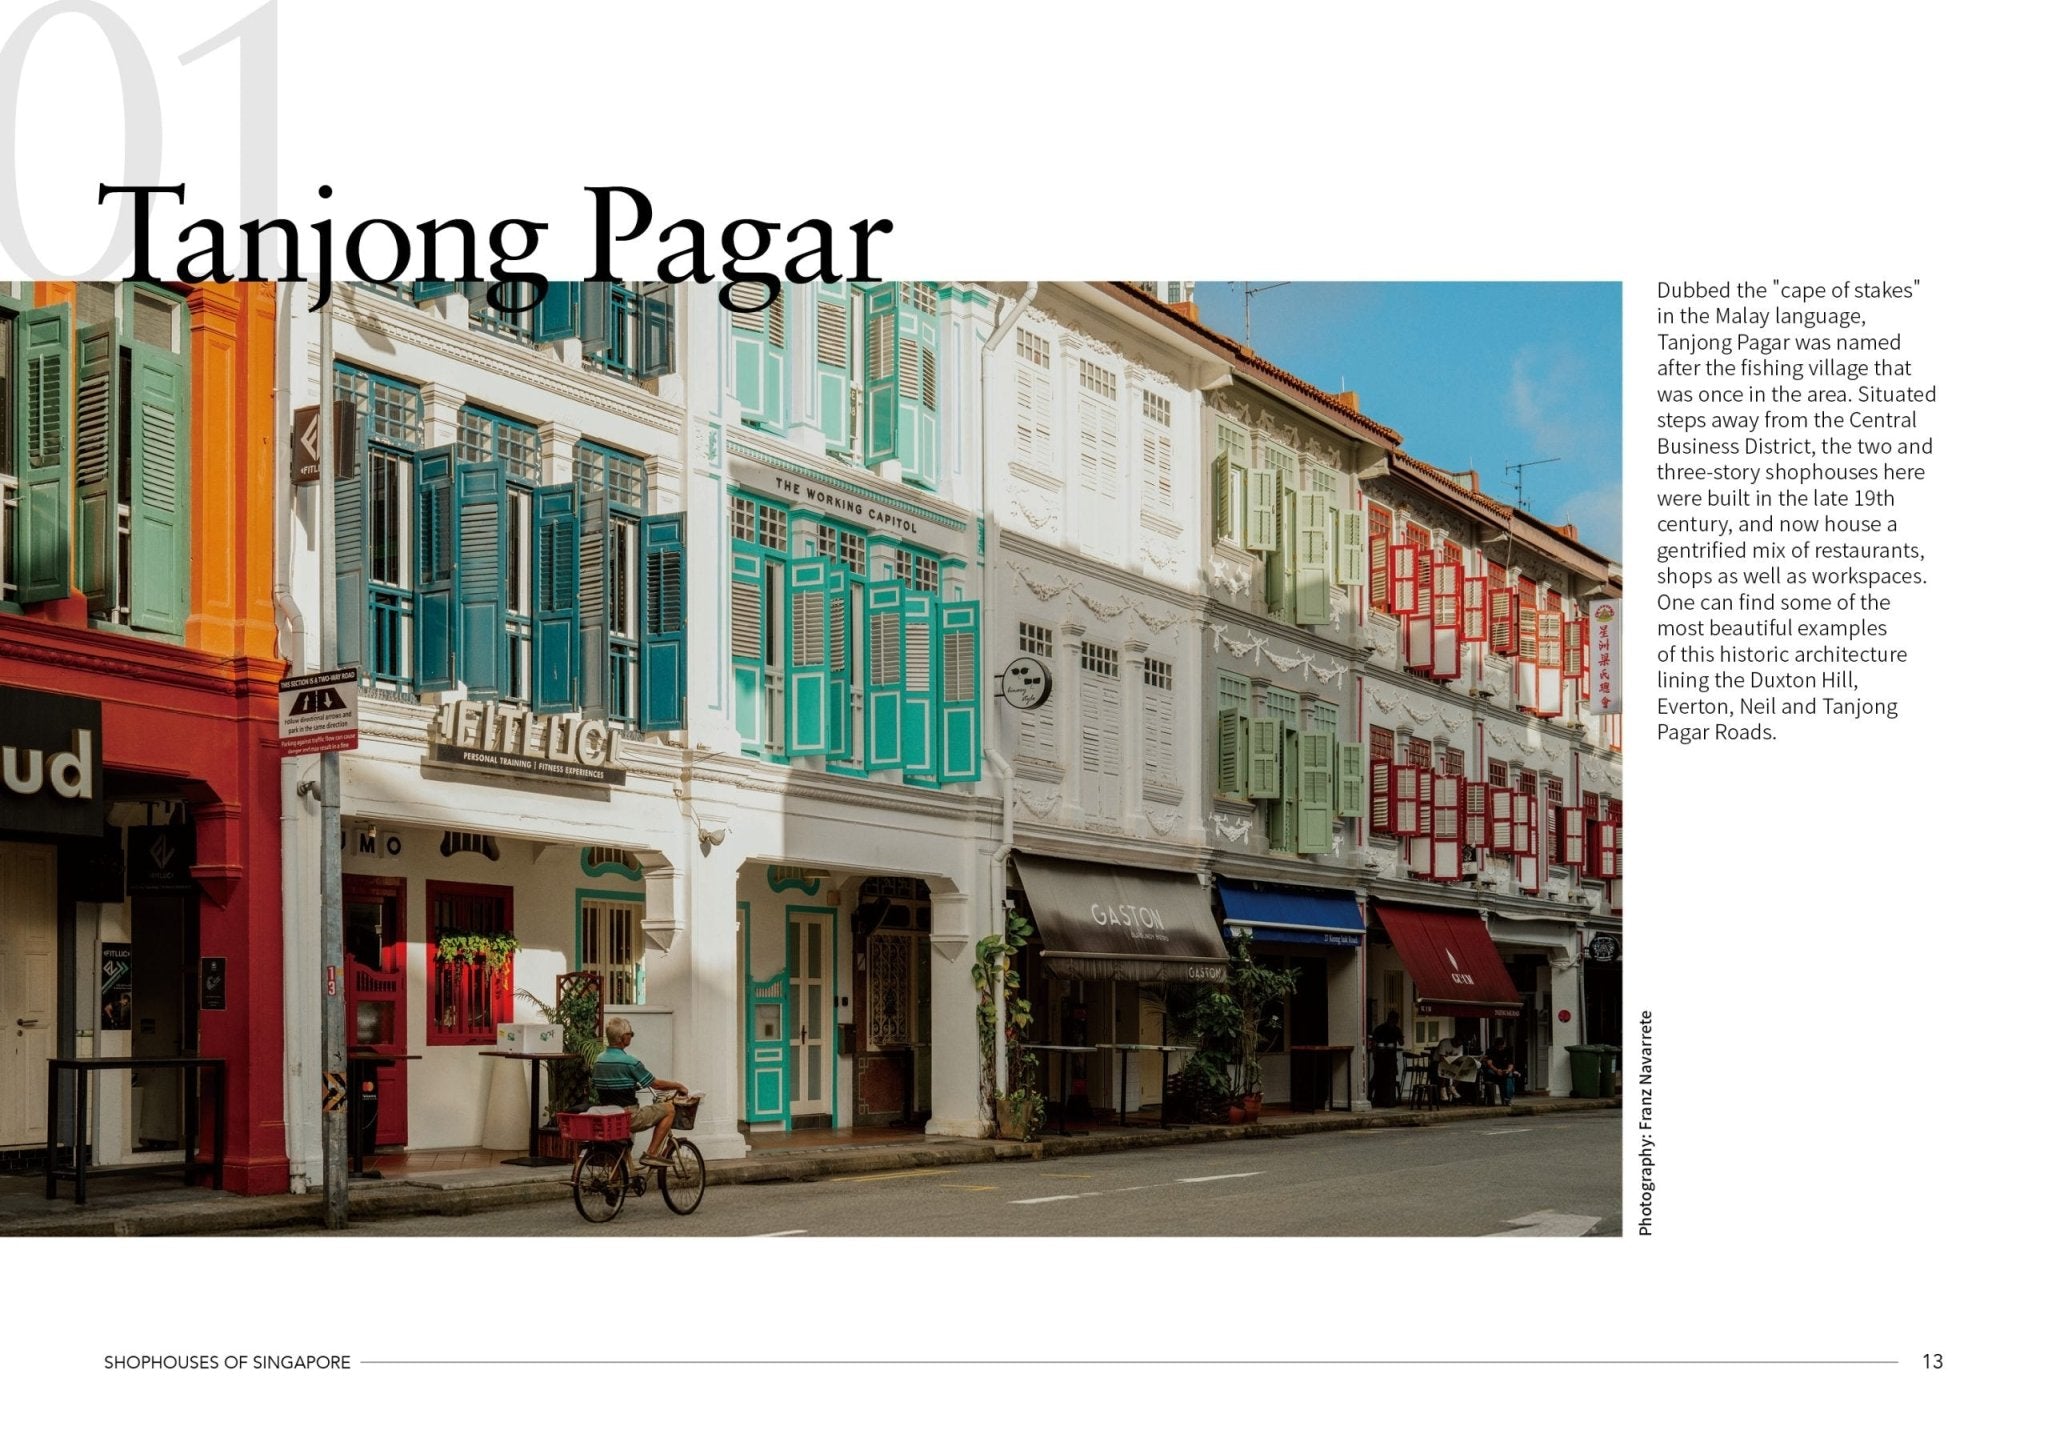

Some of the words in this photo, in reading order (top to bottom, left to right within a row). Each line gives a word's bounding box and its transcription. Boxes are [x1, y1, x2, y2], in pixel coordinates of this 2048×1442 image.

[775, 477, 800, 495] THE
[806, 487, 863, 515] WORKING
[868, 508, 917, 534] CAPITOL
[290, 679, 309, 688] SECTION
[318, 674, 341, 683] TWO-WAY
[341, 671, 355, 680] ROAD
[288, 726, 299, 735] park
[326, 721, 348, 729] direction
[463, 751, 498, 765] PERSONAL
[499, 756, 532, 770] TRAINING
[538, 762, 564, 774] FITNESS
[565, 766, 605, 780] EXPERIENCES
[1091, 903, 1165, 930] GASTON
[1188, 966, 1222, 980] GASTON
